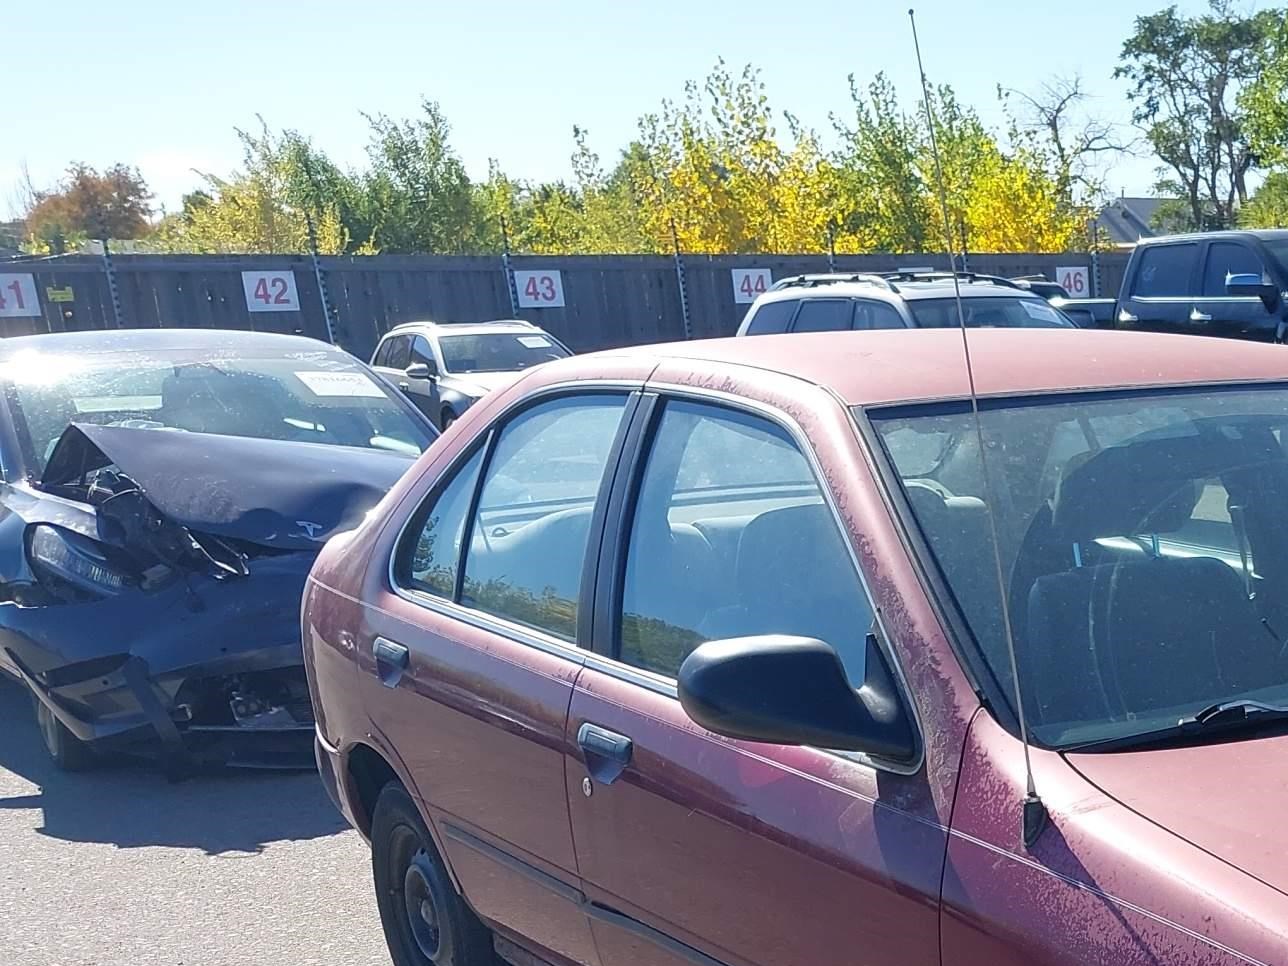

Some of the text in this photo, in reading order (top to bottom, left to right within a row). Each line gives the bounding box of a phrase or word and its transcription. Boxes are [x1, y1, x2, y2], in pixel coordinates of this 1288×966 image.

[254, 277, 291, 305] 42
[524, 275, 556, 302] 43
[740, 273, 768, 298] 44
[1062, 271, 1084, 293] 46
